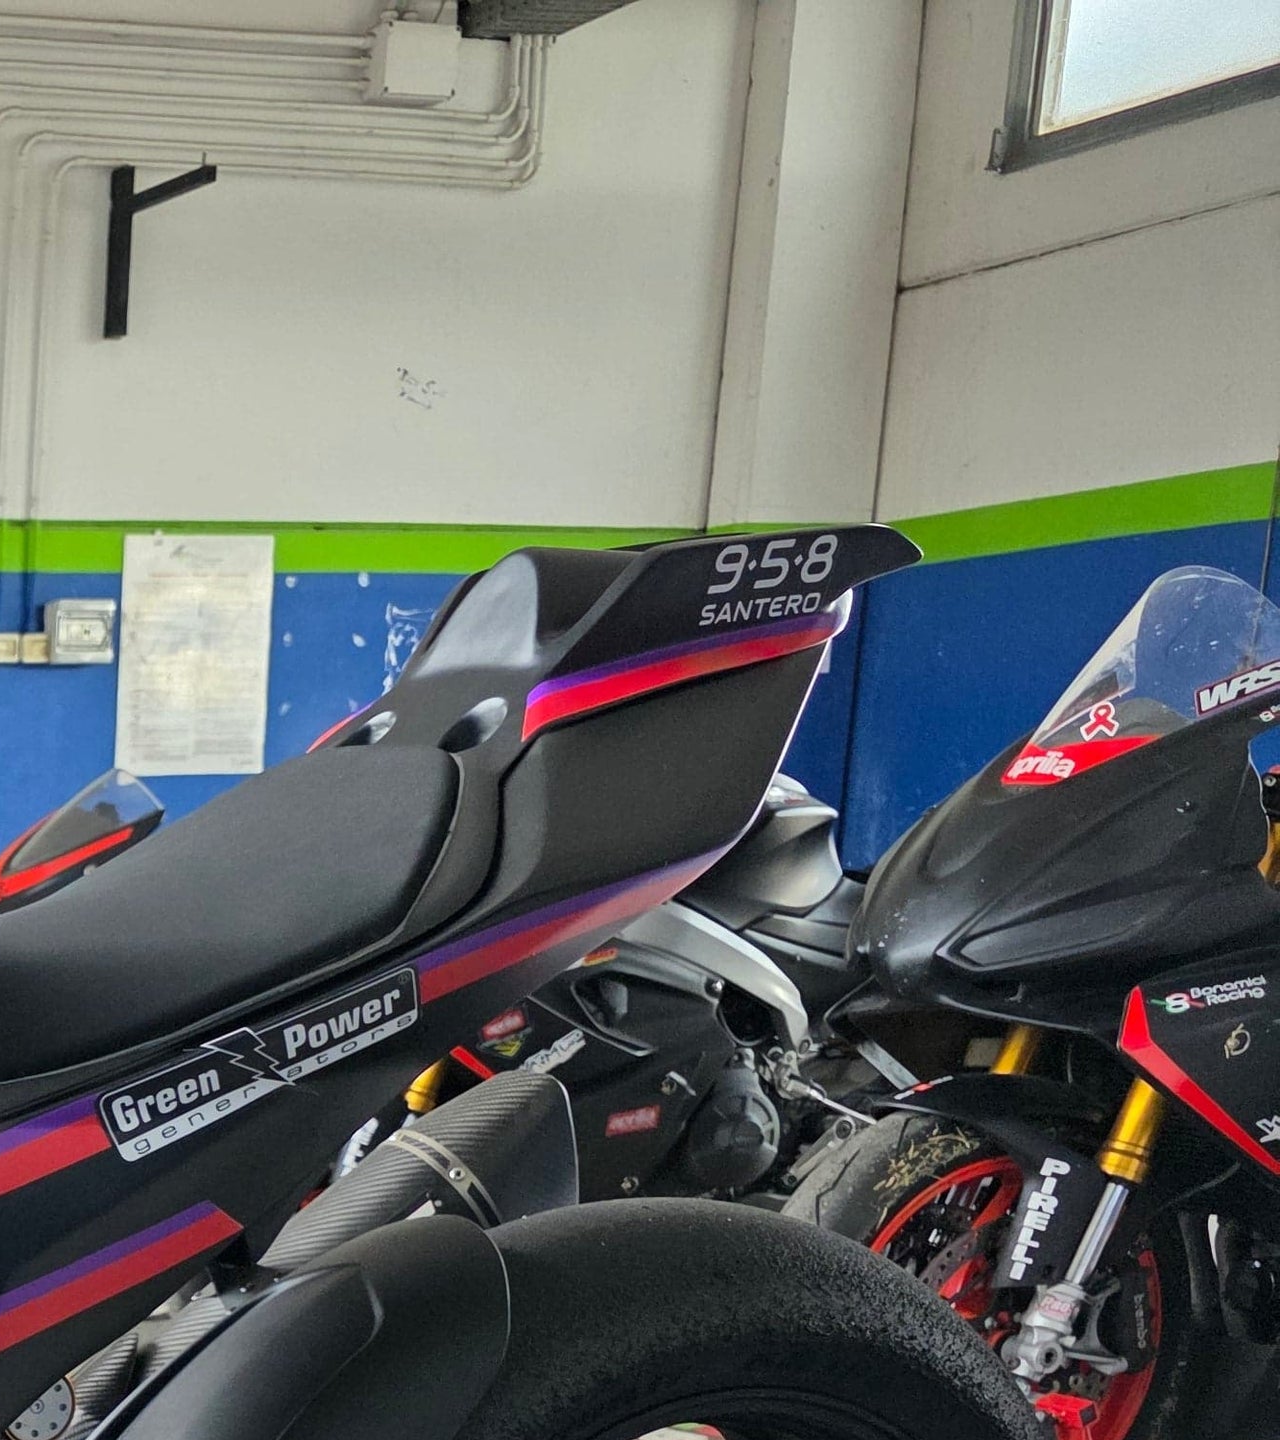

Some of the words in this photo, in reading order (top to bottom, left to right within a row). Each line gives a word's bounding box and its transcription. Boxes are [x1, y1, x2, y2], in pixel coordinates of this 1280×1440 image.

[698, 592, 822, 627] SANTERO
[1206, 986, 1266, 1006] Racing
[111, 1068, 220, 1133] Green
[283, 988, 401, 1060] Power
[1009, 1157, 1071, 1281] PIRELLI
